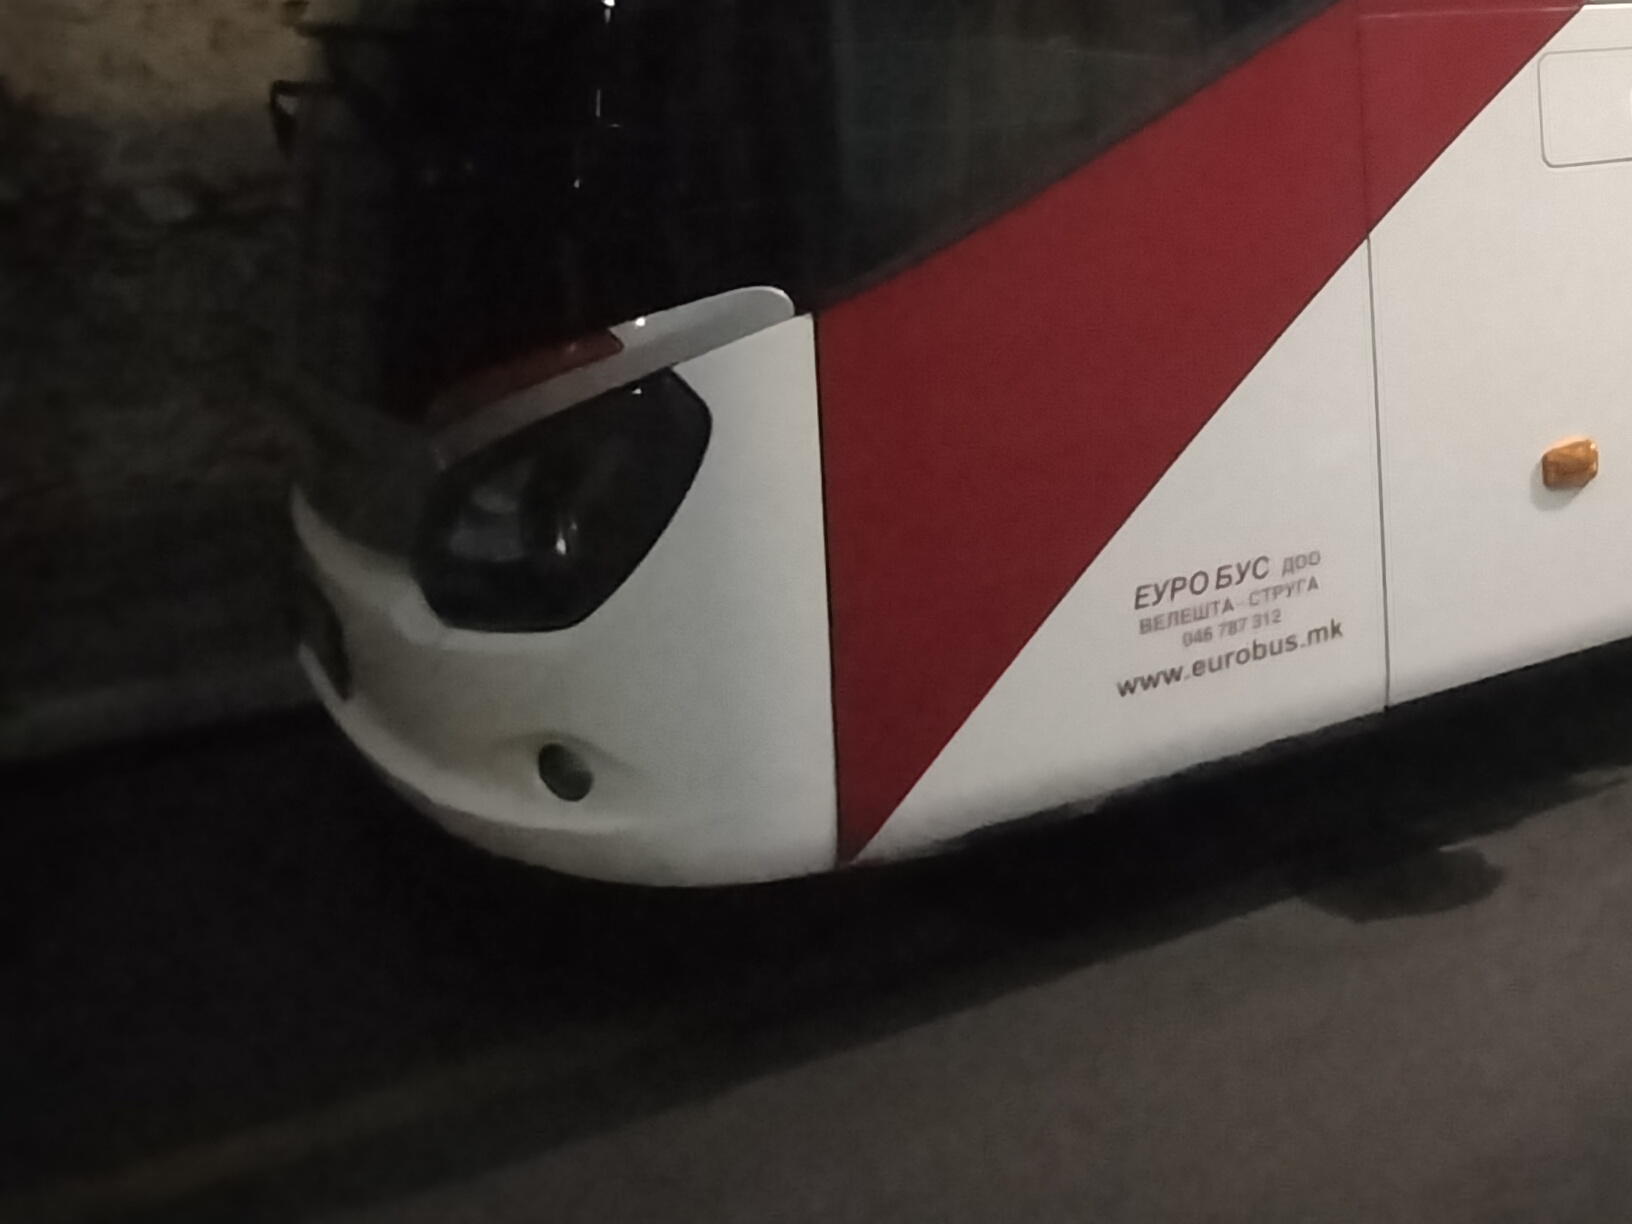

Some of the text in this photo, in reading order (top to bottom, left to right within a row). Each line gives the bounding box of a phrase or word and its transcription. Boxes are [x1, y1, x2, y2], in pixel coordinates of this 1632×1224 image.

[1134, 570, 1209, 610] ЕУРО
[1215, 555, 1270, 590] БУС
[1139, 575, 1320, 635] ВЕЛЕШТА СТРУГА
[1182, 625, 1214, 647] 046
[1252, 608, 1282, 630] 312
[1116, 618, 1344, 698] www.eurobus.mk
